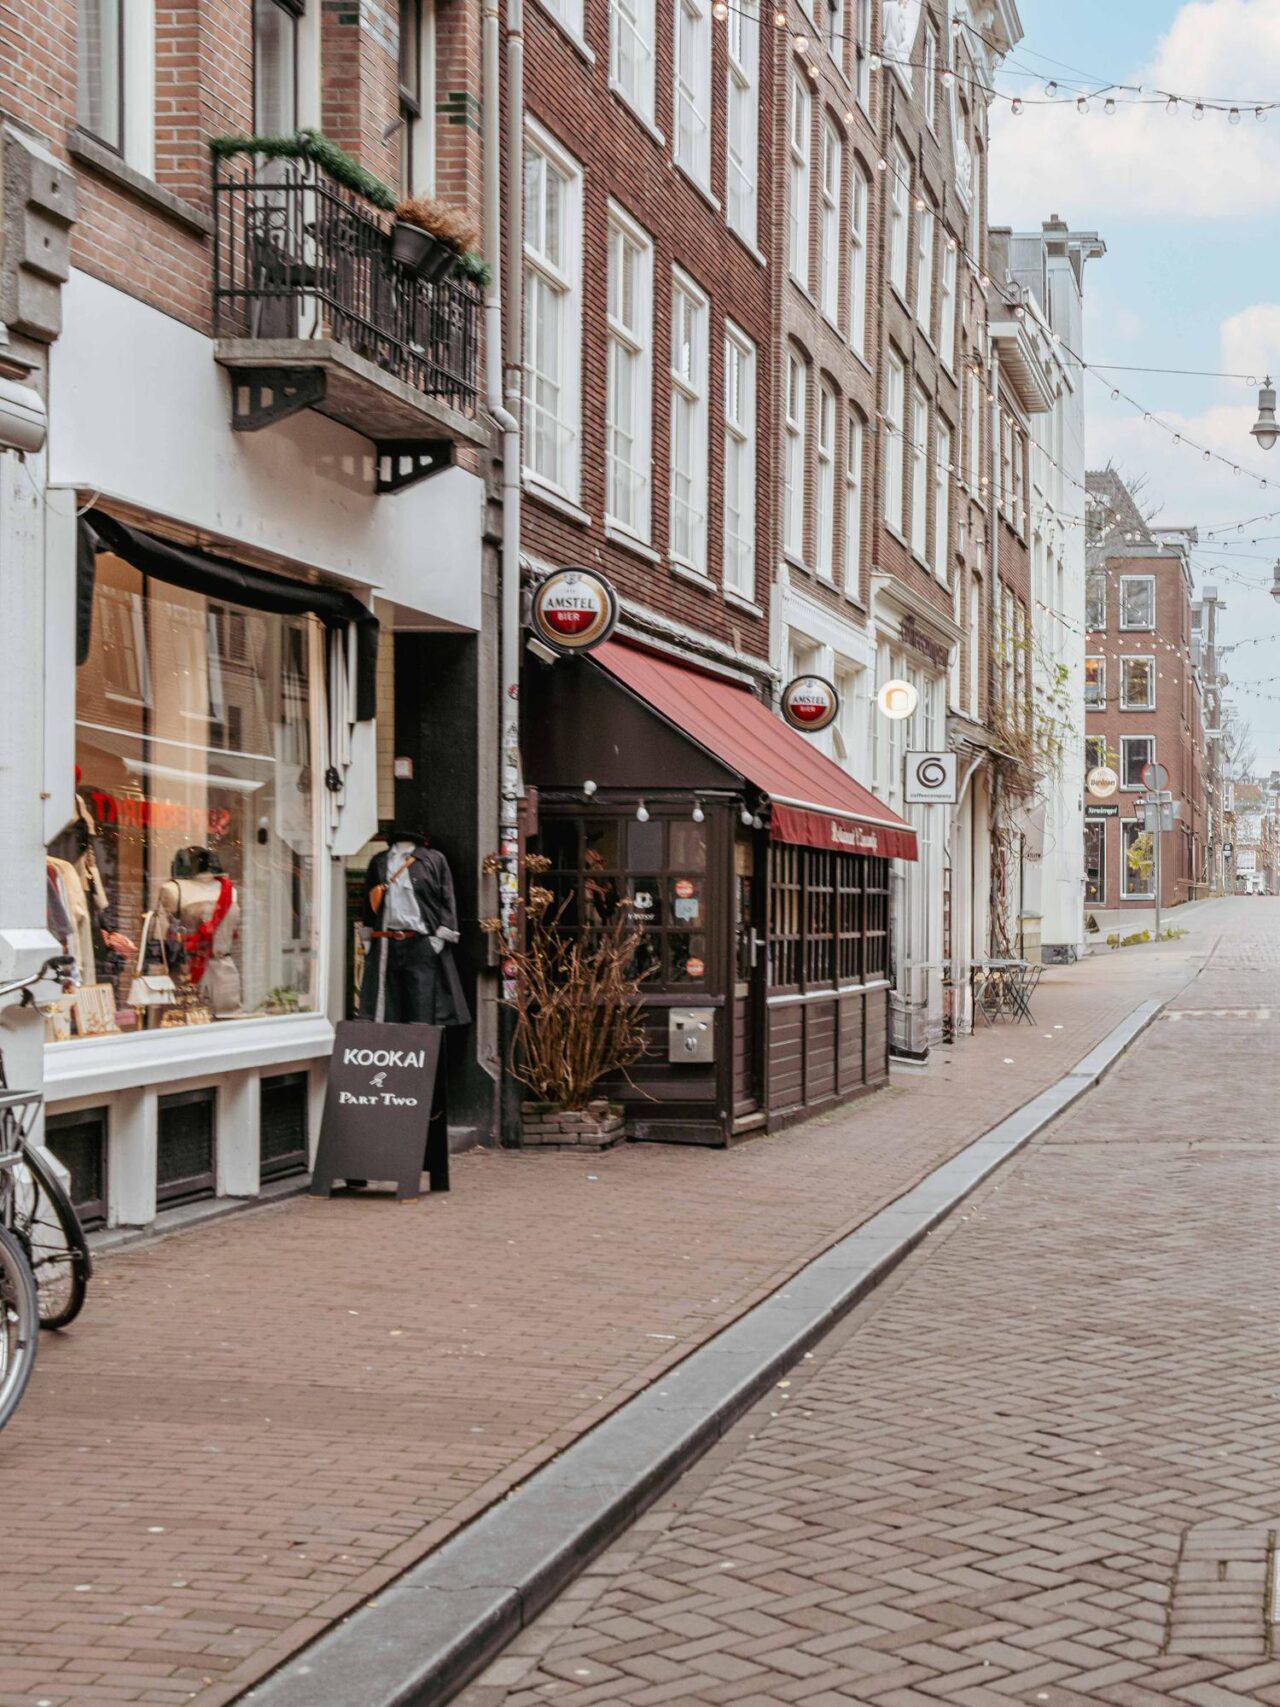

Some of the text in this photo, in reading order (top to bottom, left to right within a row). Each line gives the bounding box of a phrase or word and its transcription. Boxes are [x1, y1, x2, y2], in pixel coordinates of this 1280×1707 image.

[547, 597, 595, 609] AMSTEL
[556, 611, 581, 621] BIER
[793, 696, 825, 705] AMSTEL
[343, 1048, 425, 1068] KOOKAI
